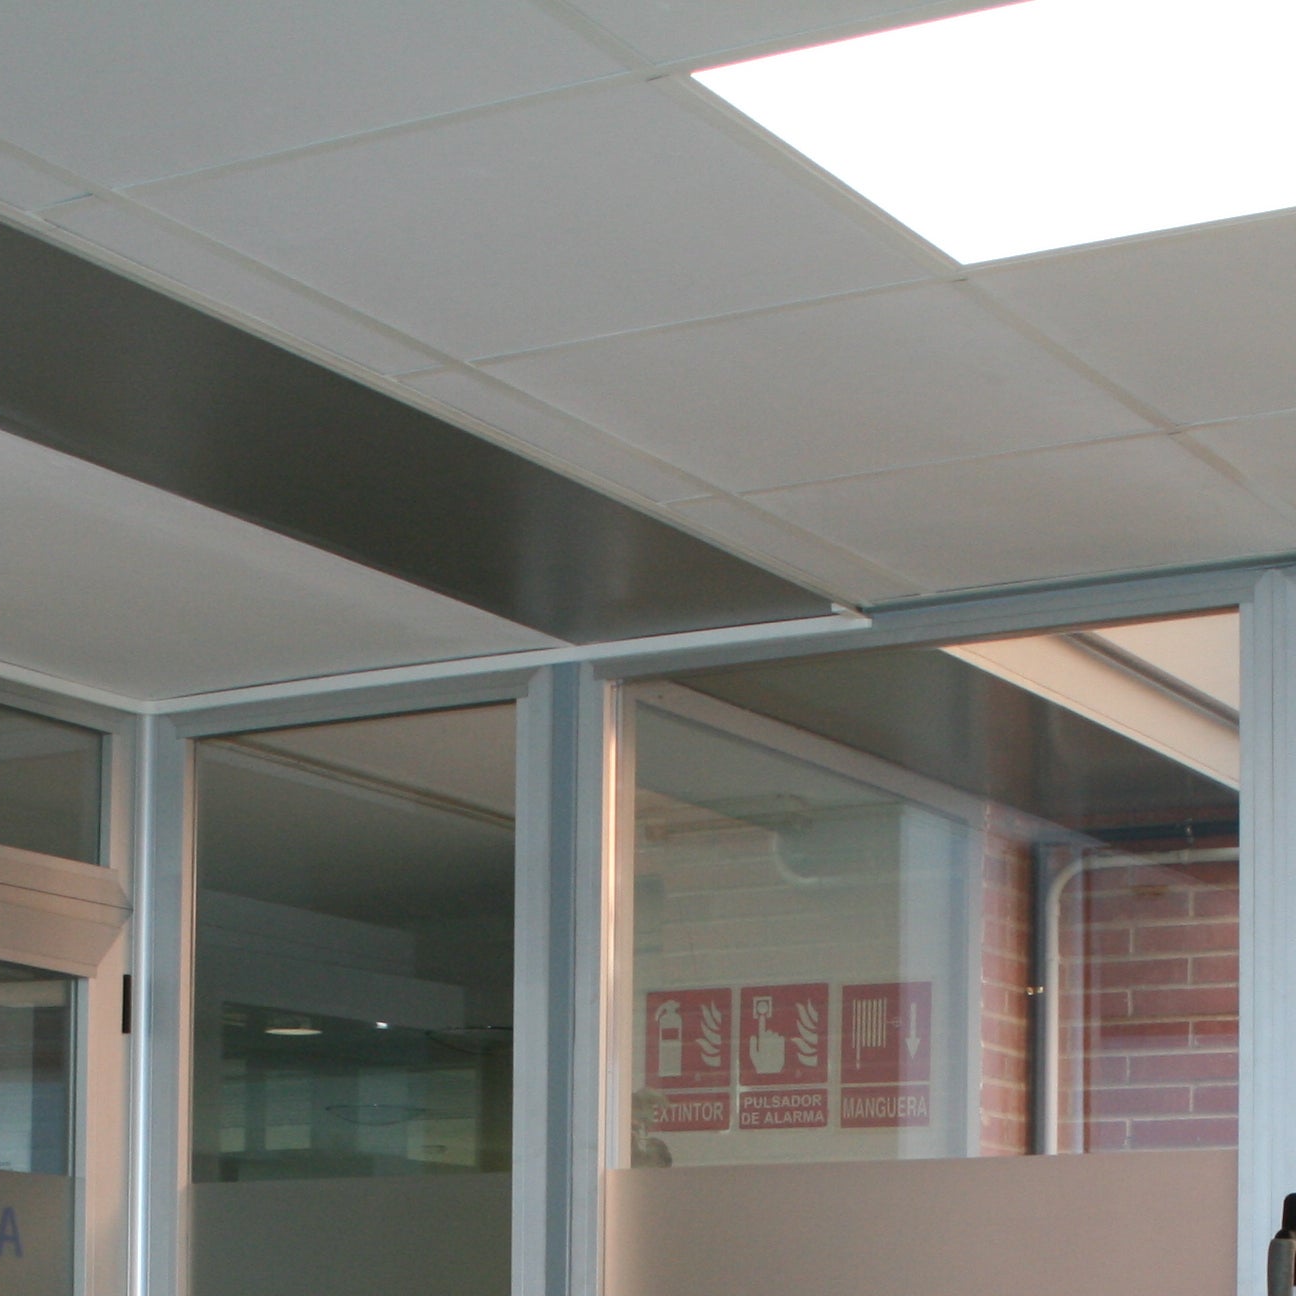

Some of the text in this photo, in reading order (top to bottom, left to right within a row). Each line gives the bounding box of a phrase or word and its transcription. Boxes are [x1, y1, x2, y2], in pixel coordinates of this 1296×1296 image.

[744, 1094, 822, 1109] PULSADOR
[843, 1095, 928, 1119] MANGUERA
[741, 1110, 824, 1125] DE ALARMA
